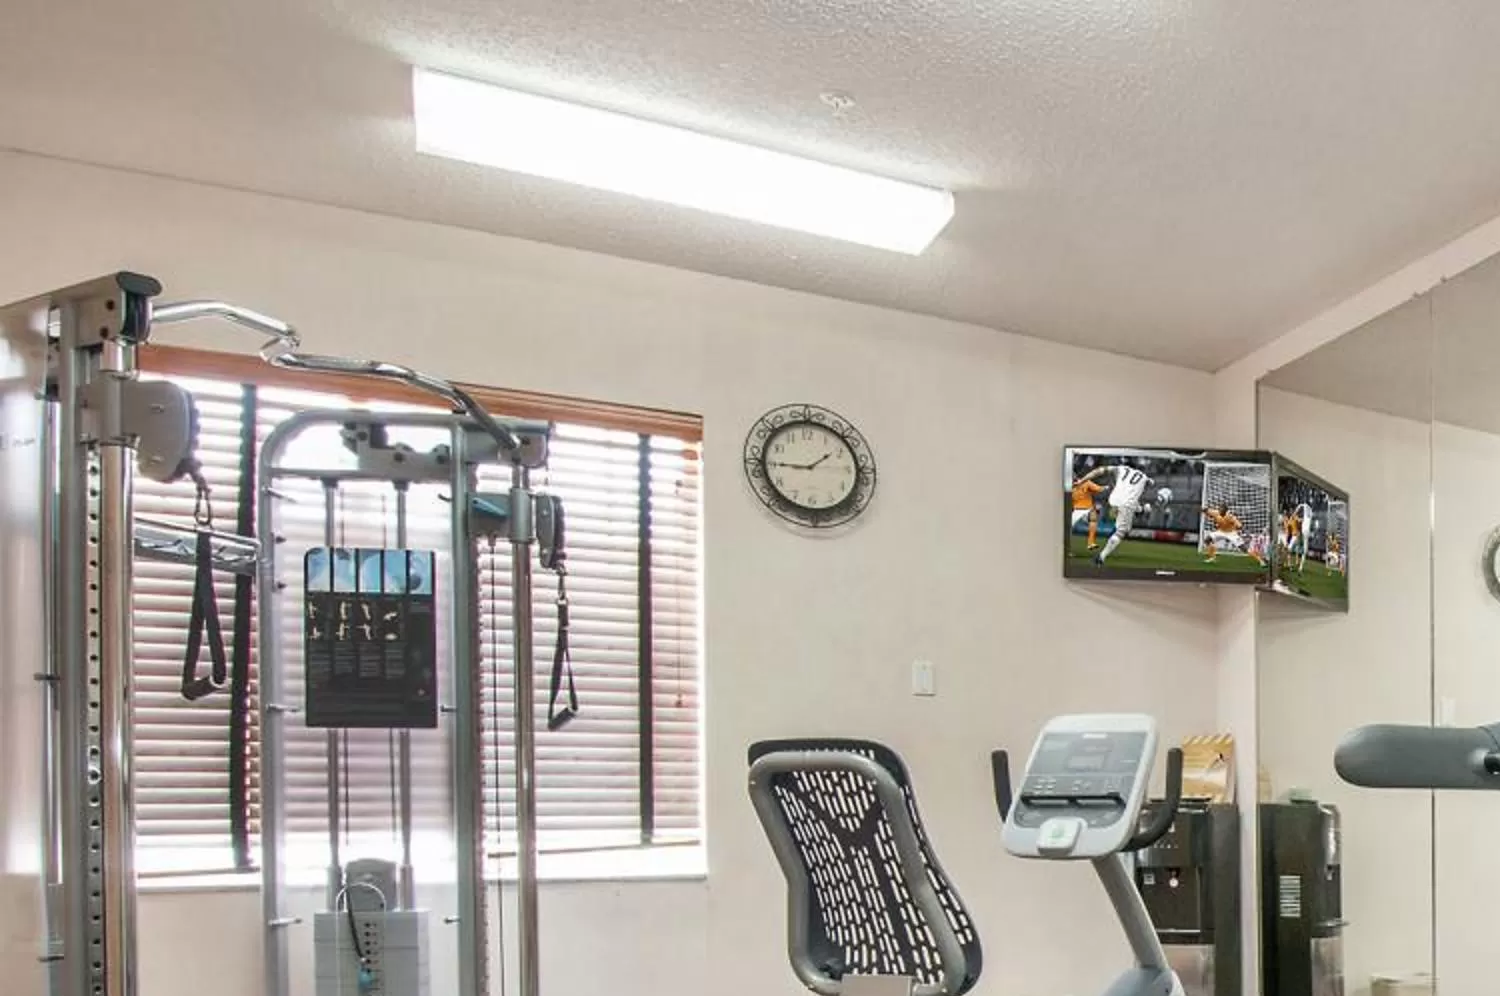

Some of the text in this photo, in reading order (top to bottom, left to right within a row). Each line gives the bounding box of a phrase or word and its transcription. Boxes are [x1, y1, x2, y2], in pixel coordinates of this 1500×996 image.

[787, 431, 795, 445] 11
[801, 427, 813, 441] 12
[1121, 467, 1144, 485] 10
